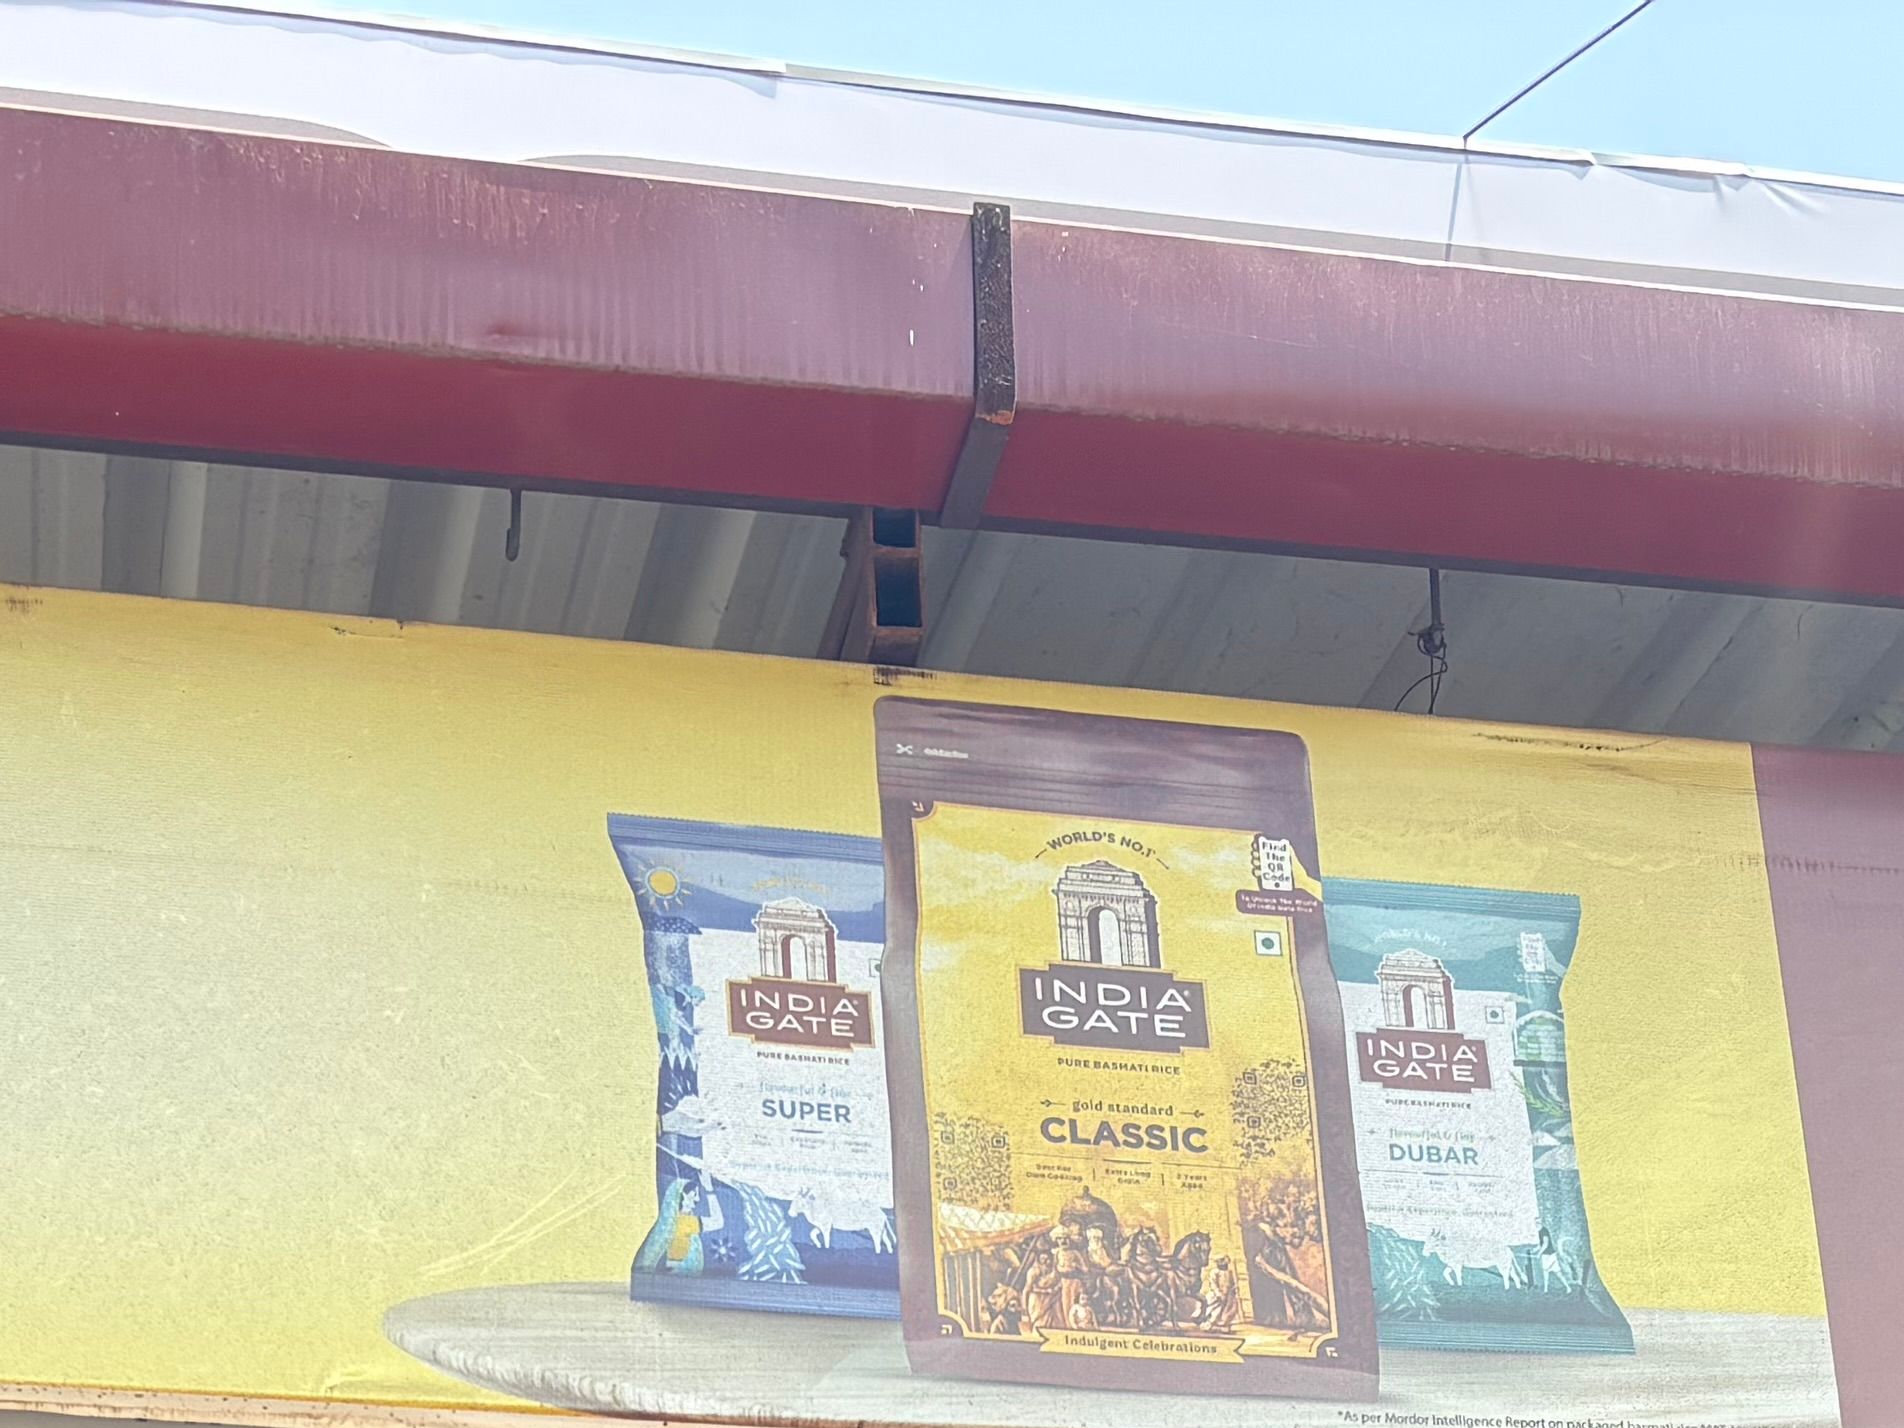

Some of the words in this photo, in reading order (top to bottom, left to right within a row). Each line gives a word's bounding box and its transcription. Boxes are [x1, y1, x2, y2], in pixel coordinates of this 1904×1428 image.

[1047, 831, 1116, 851] WORLD'S
[1262, 842, 1286, 852] Find
[1266, 852, 1285, 862] The
[1267, 862, 1284, 872] QR
[1262, 872, 1290, 883] Code
[740, 989, 859, 1017] INDIA
[1035, 977, 1192, 1013] INDIA
[746, 1011, 855, 1038] GATE
[1042, 1006, 1186, 1038] GATE
[757, 1052, 783, 1061] PURE
[1367, 1037, 1478, 1063] INDIA
[1057, 1056, 1090, 1069] PURE
[1093, 1060, 1150, 1073] BASMATI
[1152, 1063, 1181, 1075] RICE
[1373, 1060, 1475, 1083] GATE
[763, 1098, 852, 1124] SUPER
[1072, 1099, 1103, 1113] gold
[1107, 1100, 1173, 1117] standard
[1040, 1116, 1209, 1153] CLASSIC
[1389, 1143, 1478, 1166] DUBAR
[1065, 1335, 1128, 1351] Indulgent
[1132, 1336, 1217, 1354] Celebrations
[1361, 1413, 1381, 1427] per
[1384, 1411, 1429, 1426] Mordor
